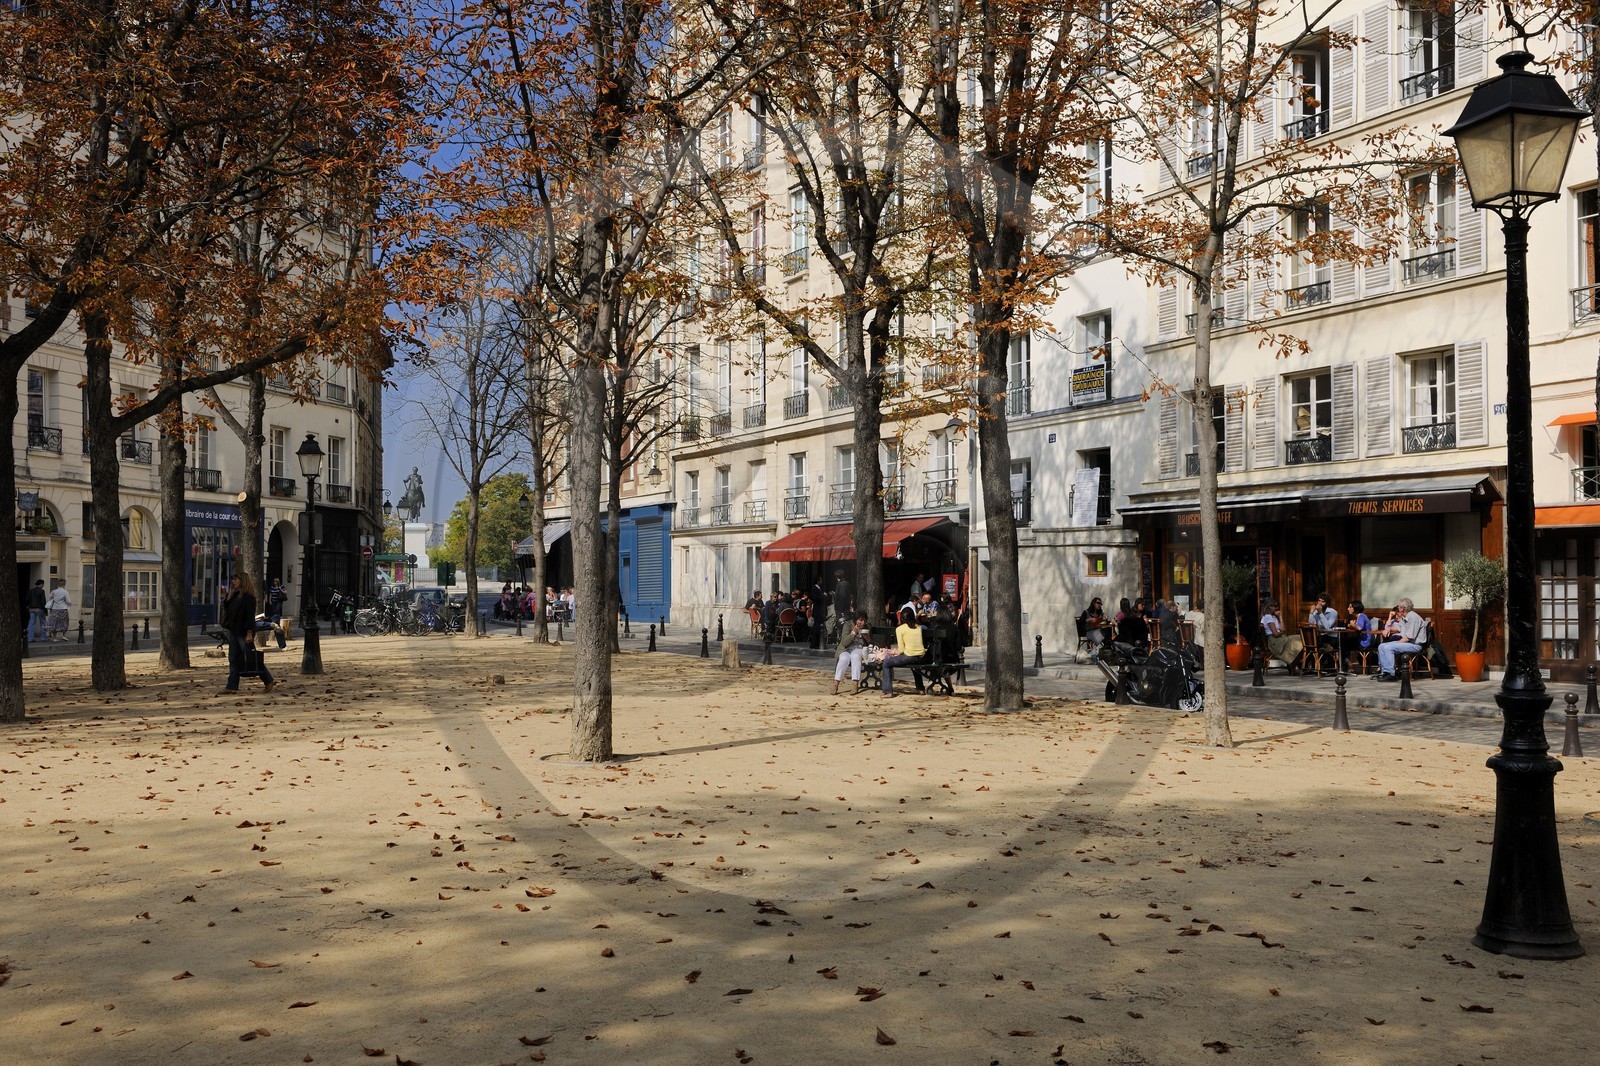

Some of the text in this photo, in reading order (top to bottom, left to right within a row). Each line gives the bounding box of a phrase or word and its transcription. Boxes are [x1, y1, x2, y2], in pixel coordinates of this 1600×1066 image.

[1073, 370, 1105, 381] DURANCE
[1072, 379, 1105, 391] THIBAULT
[1348, 498, 1424, 514] THEMIS SERVICES
[205, 511, 212, 519] de
[213, 511, 218, 520] la
[231, 513, 238, 521] de
